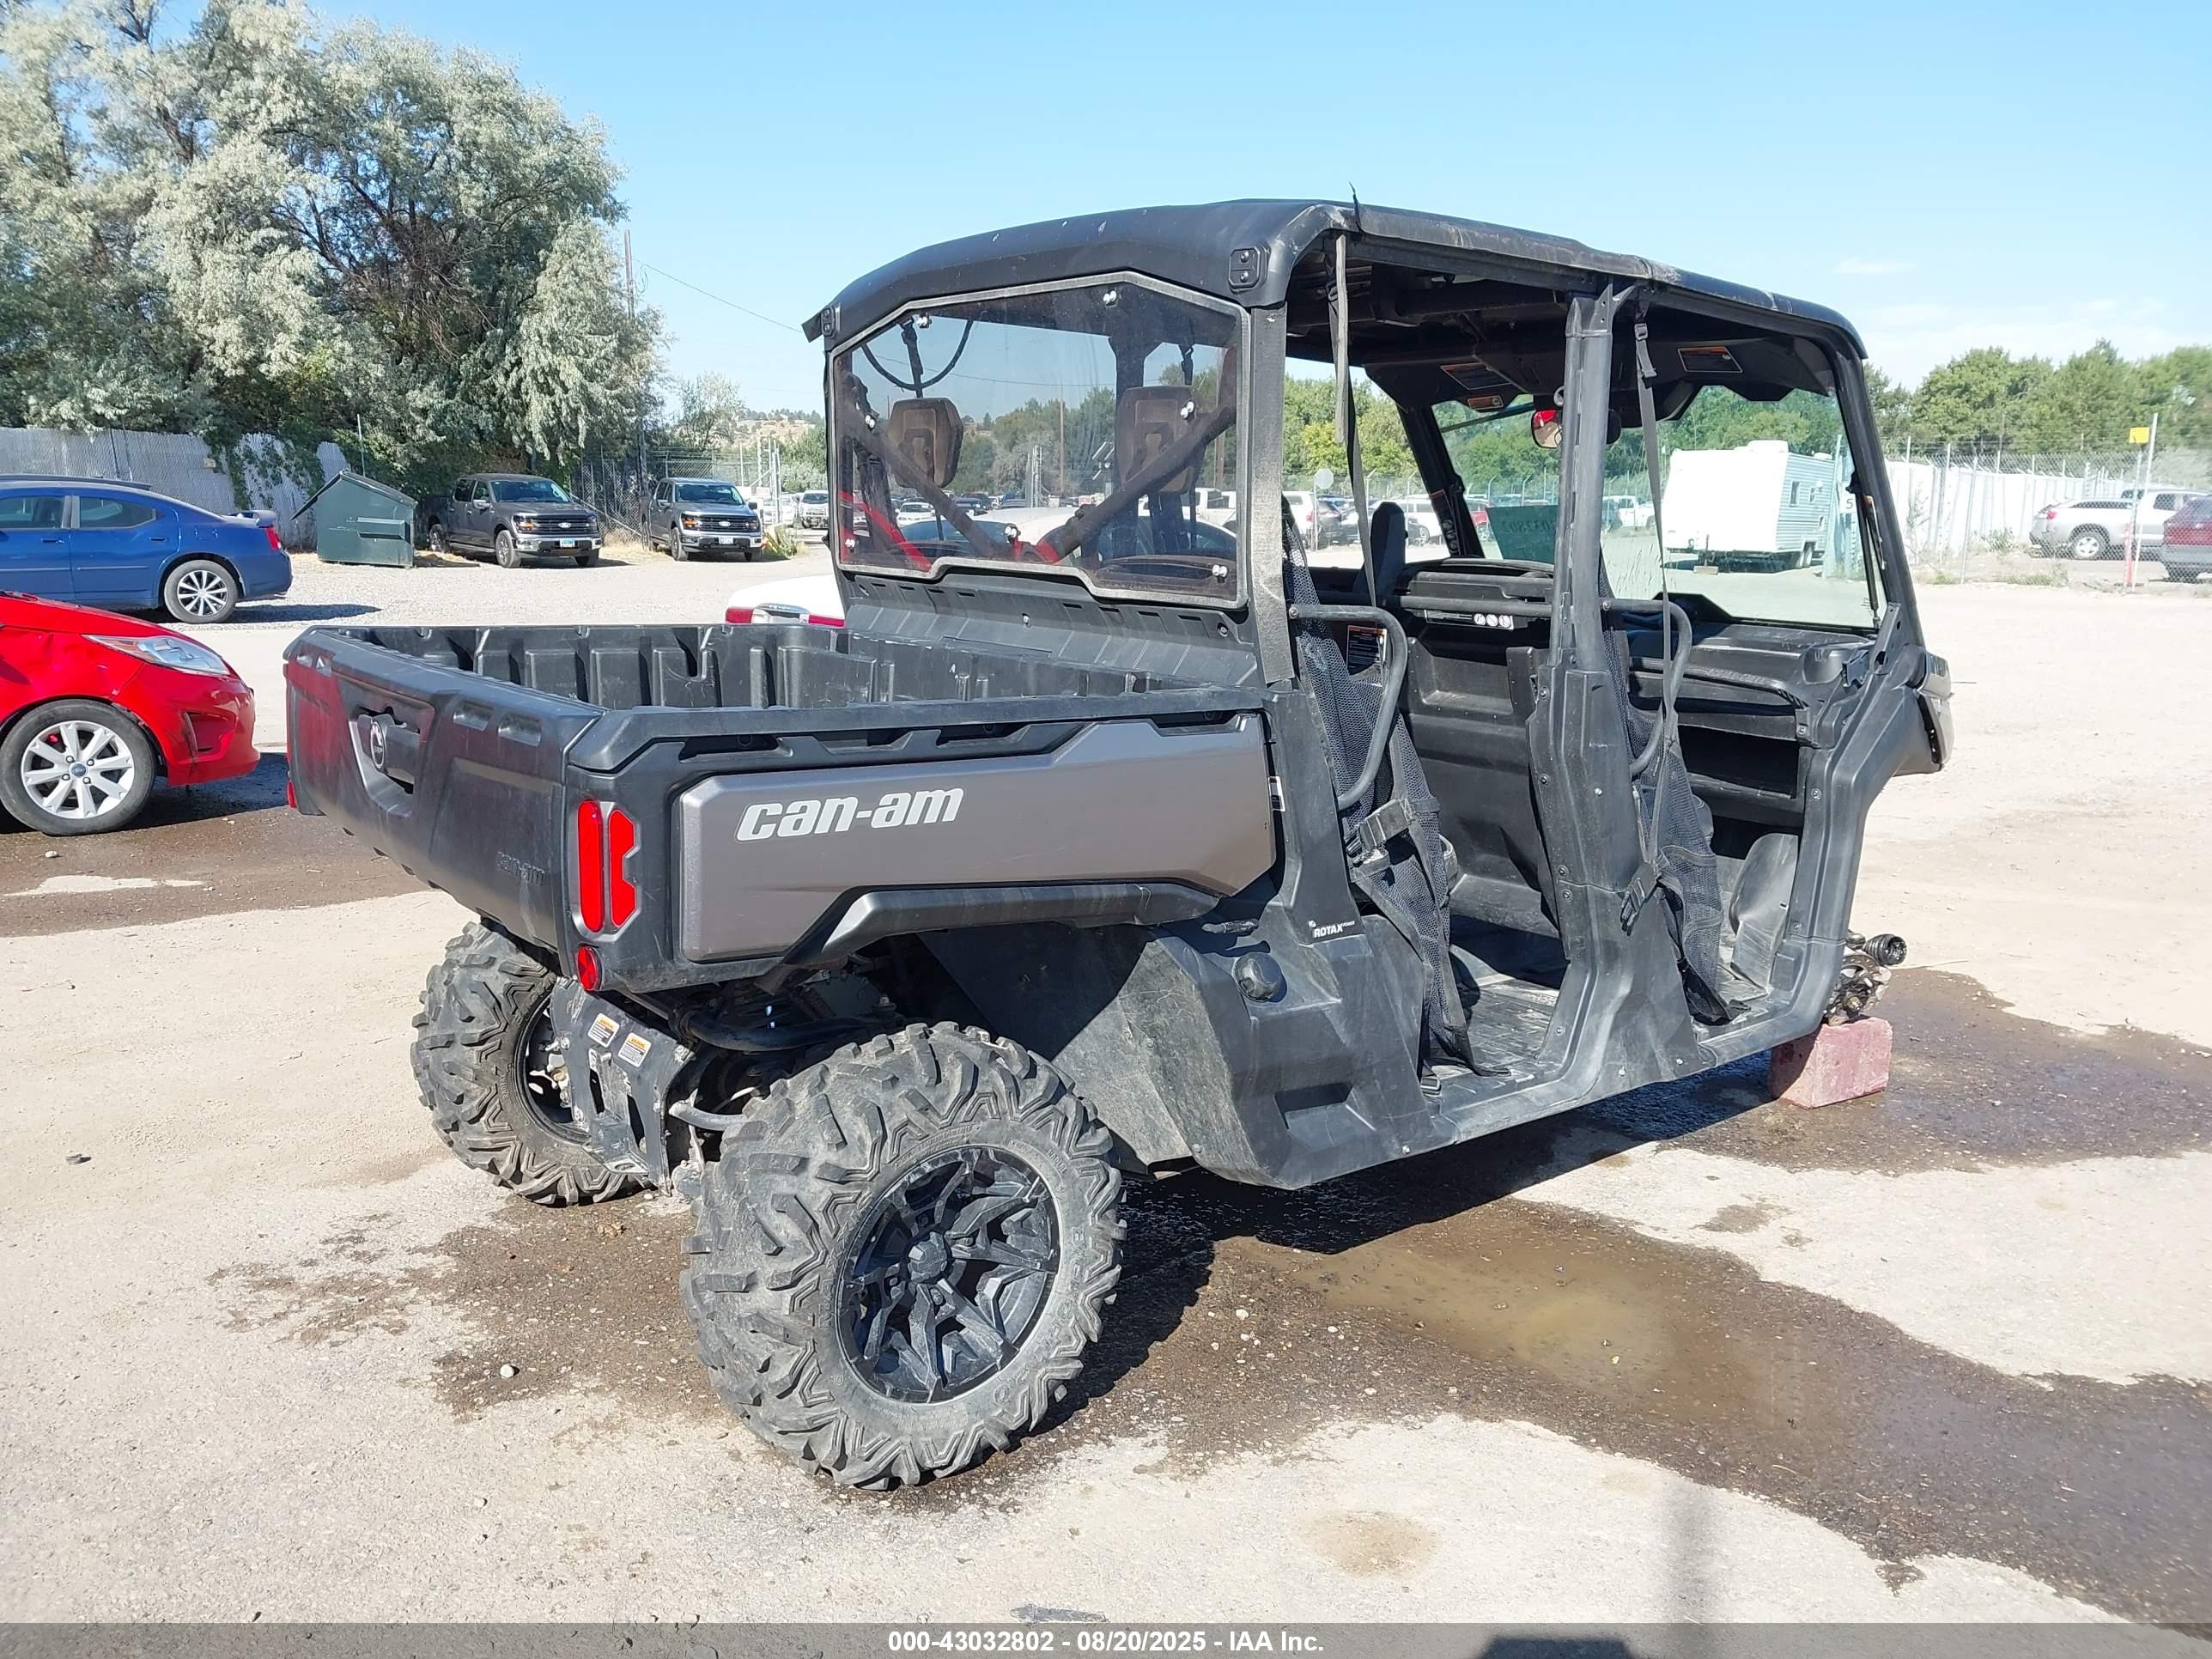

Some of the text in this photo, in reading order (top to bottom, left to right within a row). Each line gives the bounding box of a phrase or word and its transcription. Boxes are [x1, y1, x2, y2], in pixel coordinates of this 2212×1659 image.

[1845, 498, 1854, 510] 5
[736, 787, 964, 842] can-am
[1313, 923, 1344, 939] ROTAX
